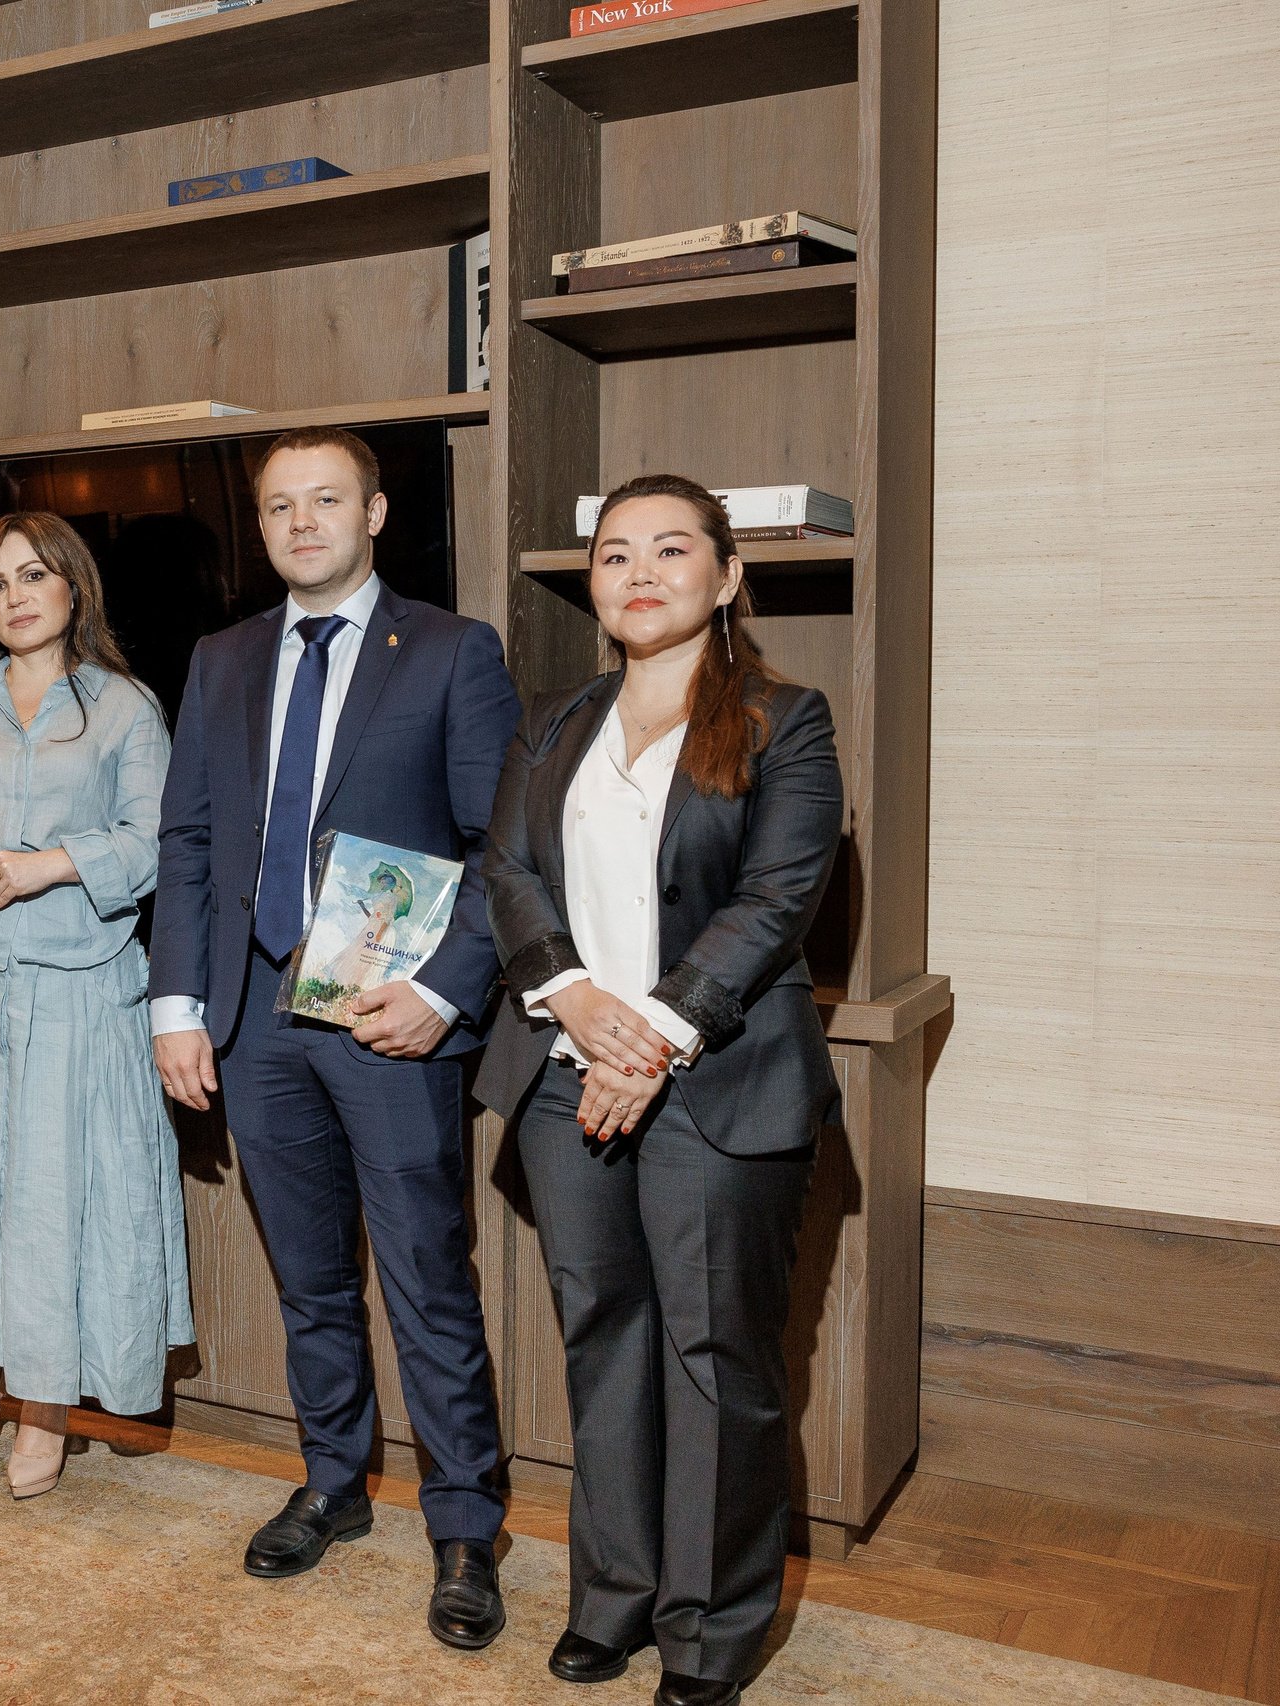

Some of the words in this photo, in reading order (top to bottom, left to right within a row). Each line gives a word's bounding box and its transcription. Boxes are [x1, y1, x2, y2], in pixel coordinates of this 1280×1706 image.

[590, 7, 629, 27] New
[630, 0, 674, 18] York
[363, 940, 423, 962] ЖЕНЩИНАХ
